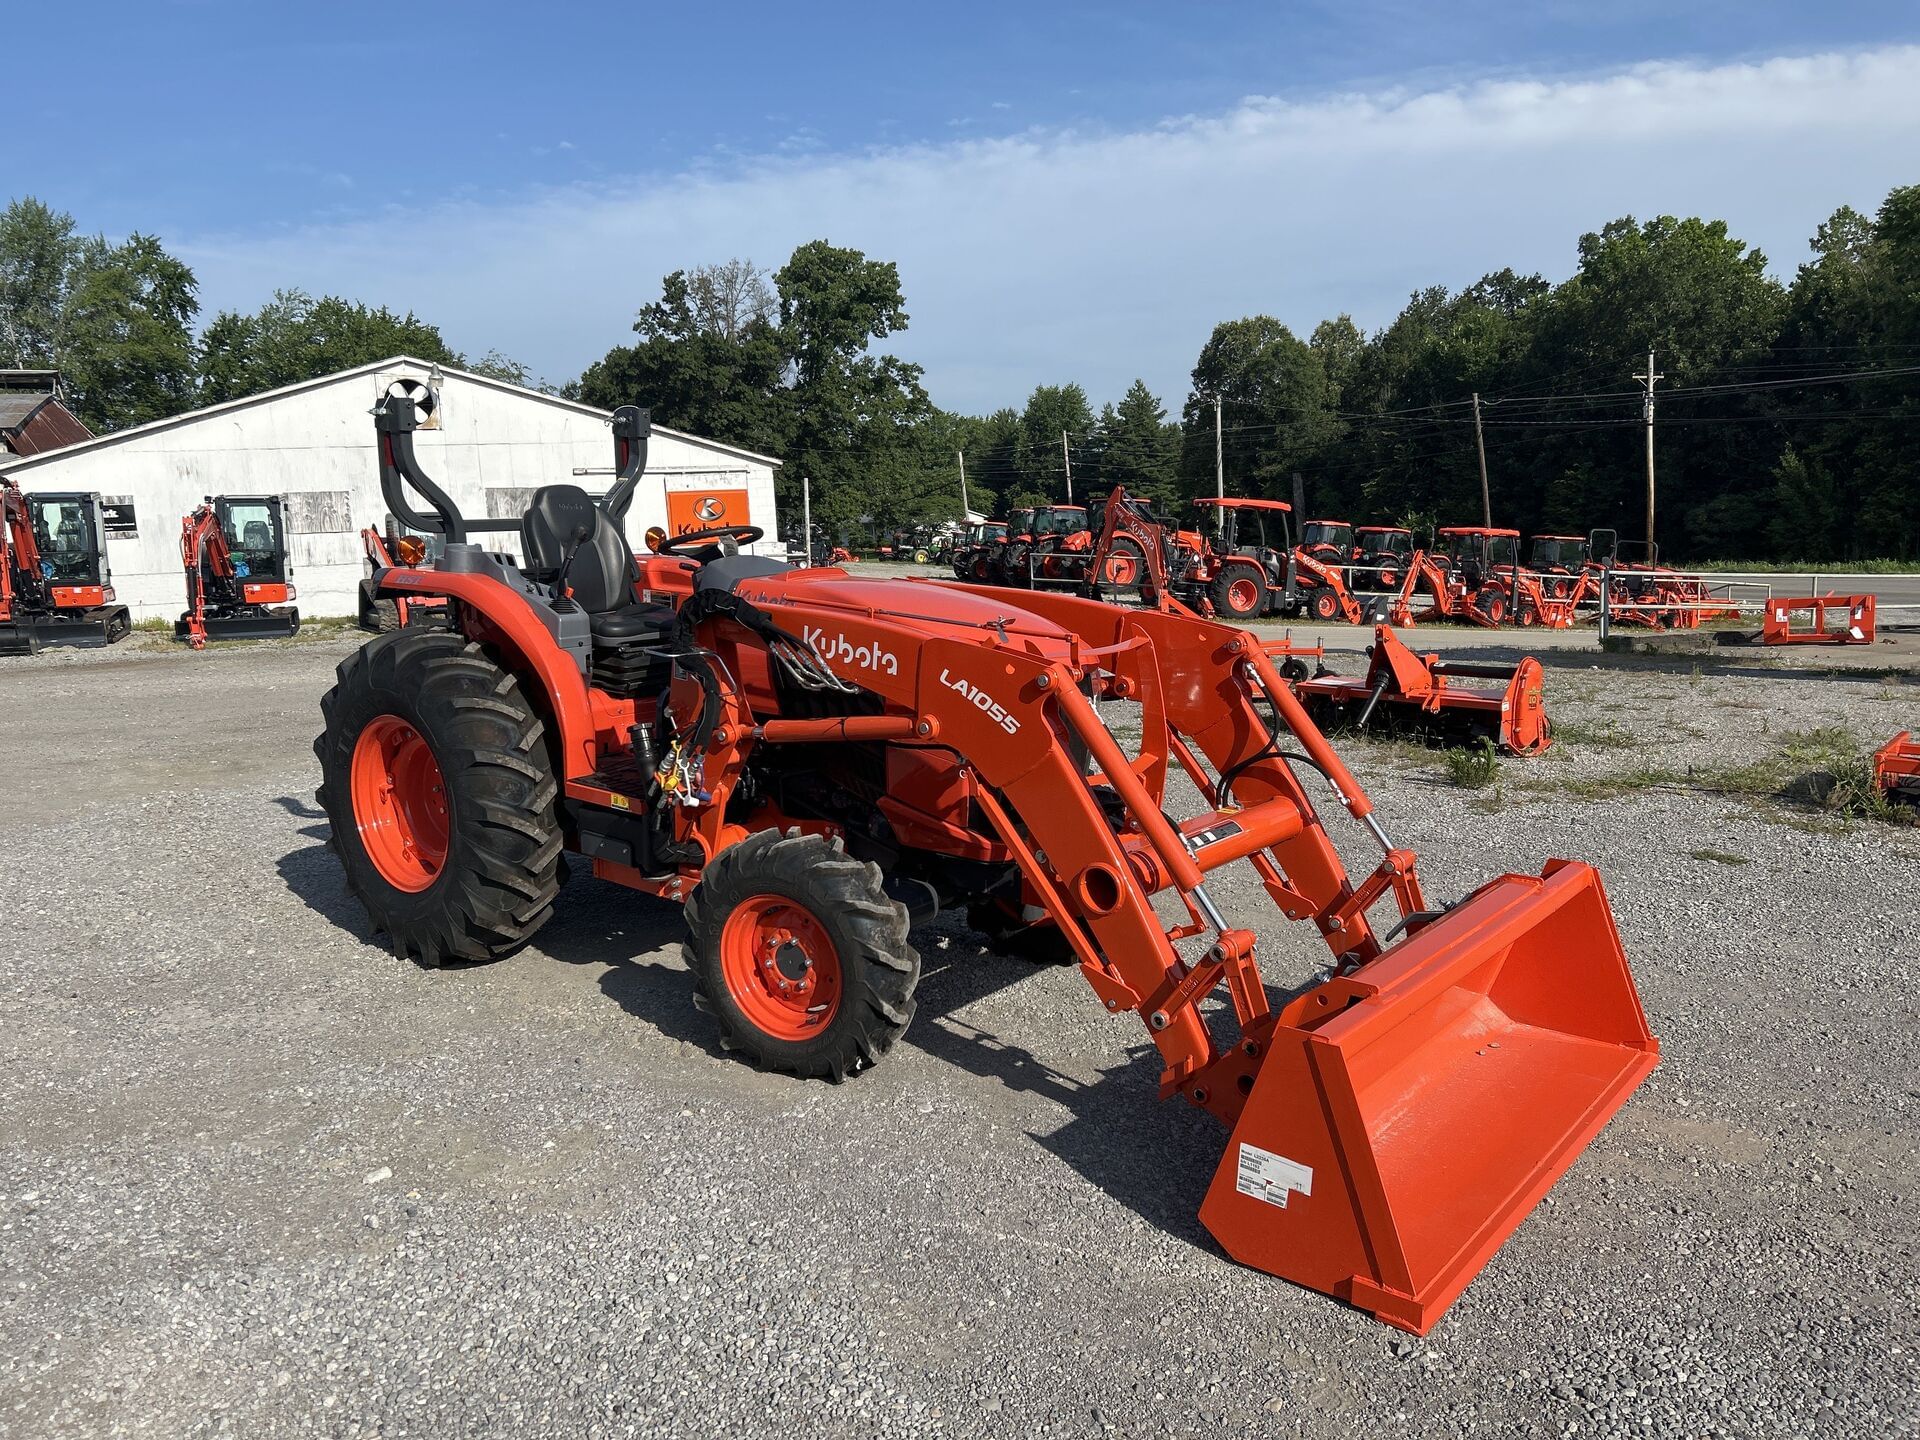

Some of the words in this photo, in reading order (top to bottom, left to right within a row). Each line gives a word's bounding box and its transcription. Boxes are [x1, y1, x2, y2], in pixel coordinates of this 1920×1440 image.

[1129, 520, 1155, 550] Kubota
[1302, 554, 1327, 574] Kubota
[803, 624, 898, 676] Kubota
[939, 668, 1021, 735] LA1055
